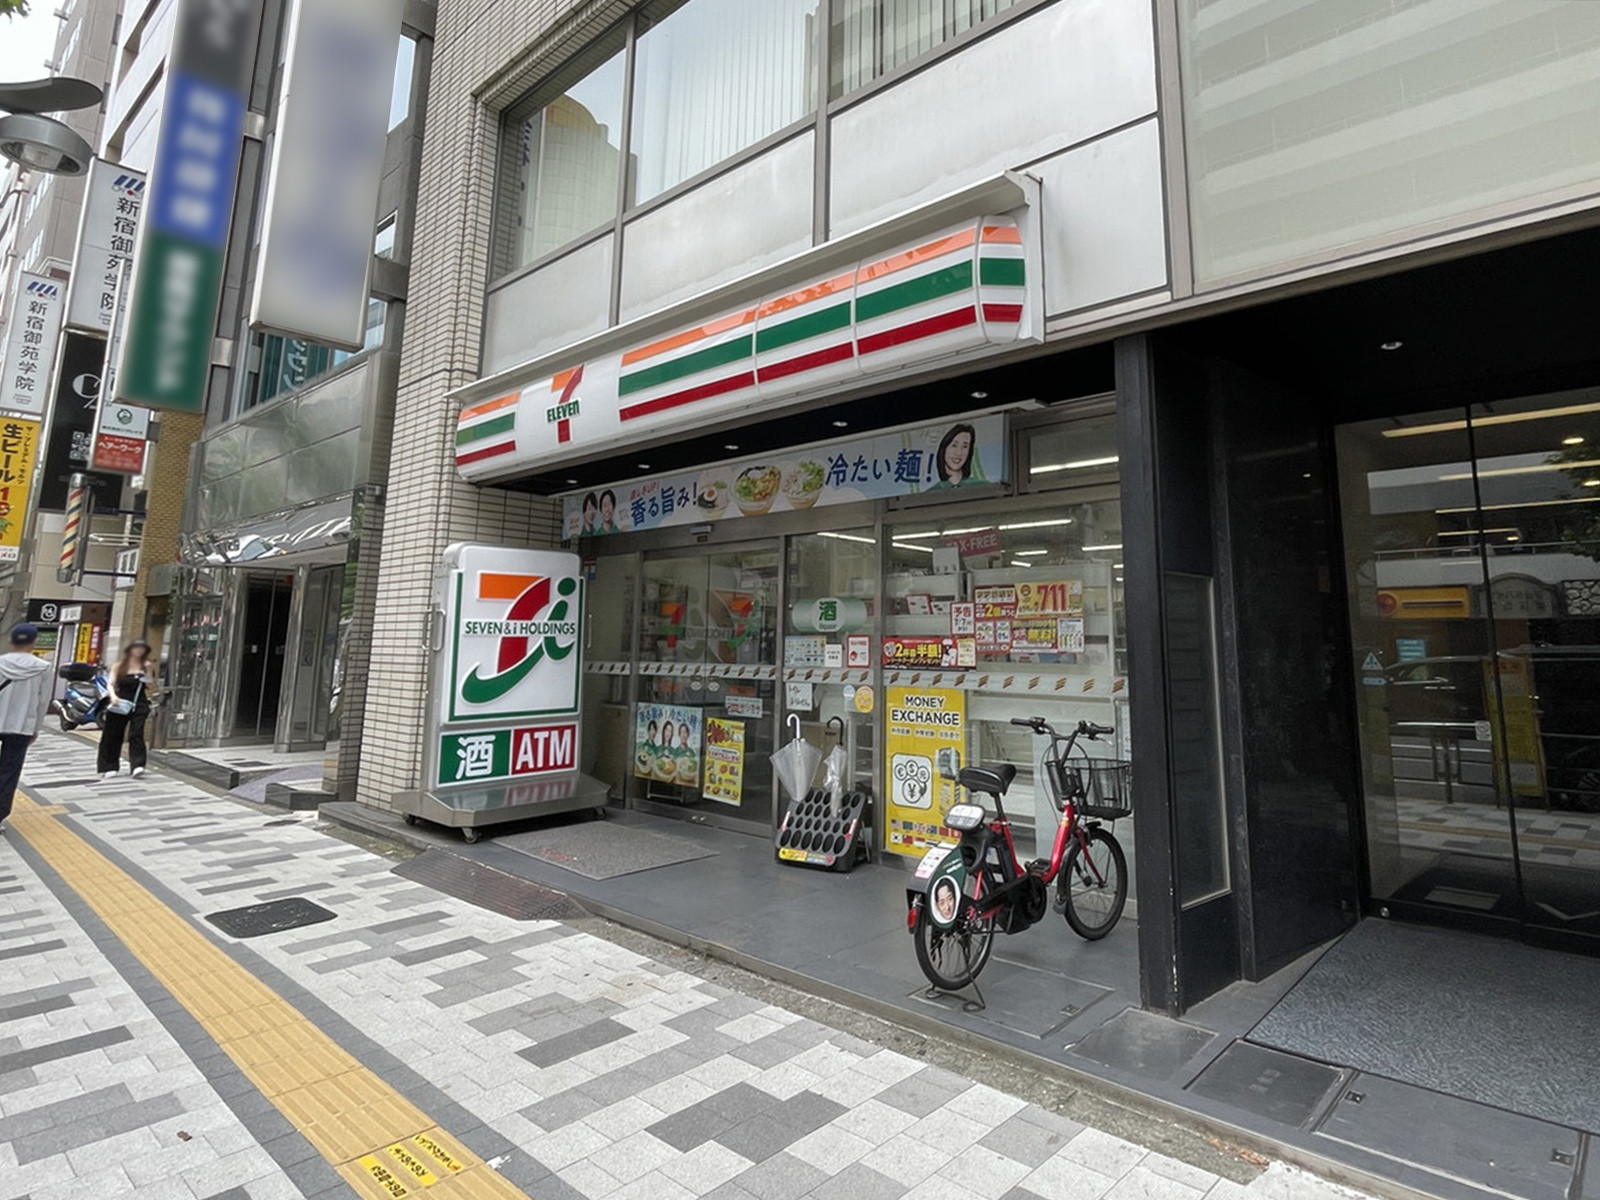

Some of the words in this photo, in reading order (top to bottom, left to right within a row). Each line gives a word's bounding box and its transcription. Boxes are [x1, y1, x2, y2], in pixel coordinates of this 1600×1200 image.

[15, 301, 48, 391] 新宿御苑学院
[826, 449, 934, 487] 冷たい麺!
[630, 481, 698, 527] 香る旨み!
[819, 601, 837, 621] 酒
[1037, 583, 1067, 611] 711
[520, 621, 576, 635] HOLDINGS
[891, 709, 960, 726] EXCHANGE
[905, 696, 945, 708] MONEY
[455, 734, 496, 780] 酒
[515, 729, 572, 770] ATM
